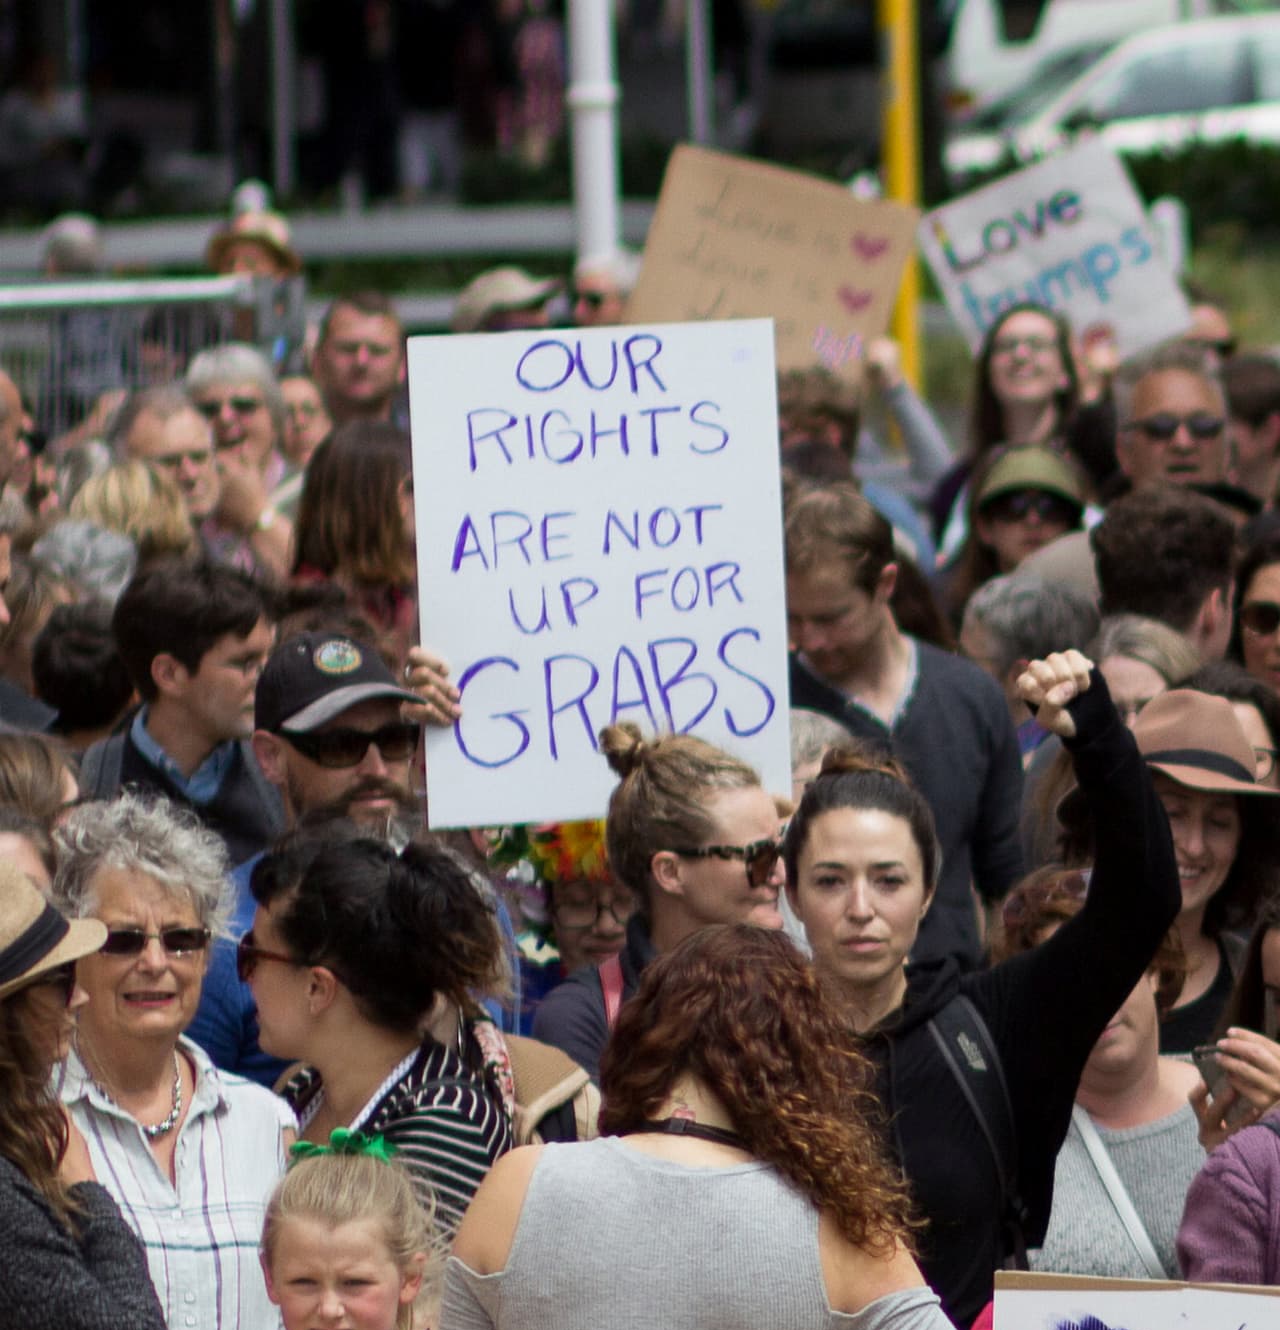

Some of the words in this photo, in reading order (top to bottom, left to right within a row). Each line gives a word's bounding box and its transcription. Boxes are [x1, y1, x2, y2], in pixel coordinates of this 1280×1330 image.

[934, 190, 1083, 272] Love
[516, 335, 667, 394] OUR
[466, 401, 730, 473] RIGHTS
[450, 511, 576, 574] ARE
[602, 504, 723, 556] NOT
[508, 577, 599, 635] UP
[634, 561, 744, 621] FOR
[454, 627, 777, 769] GRABS
